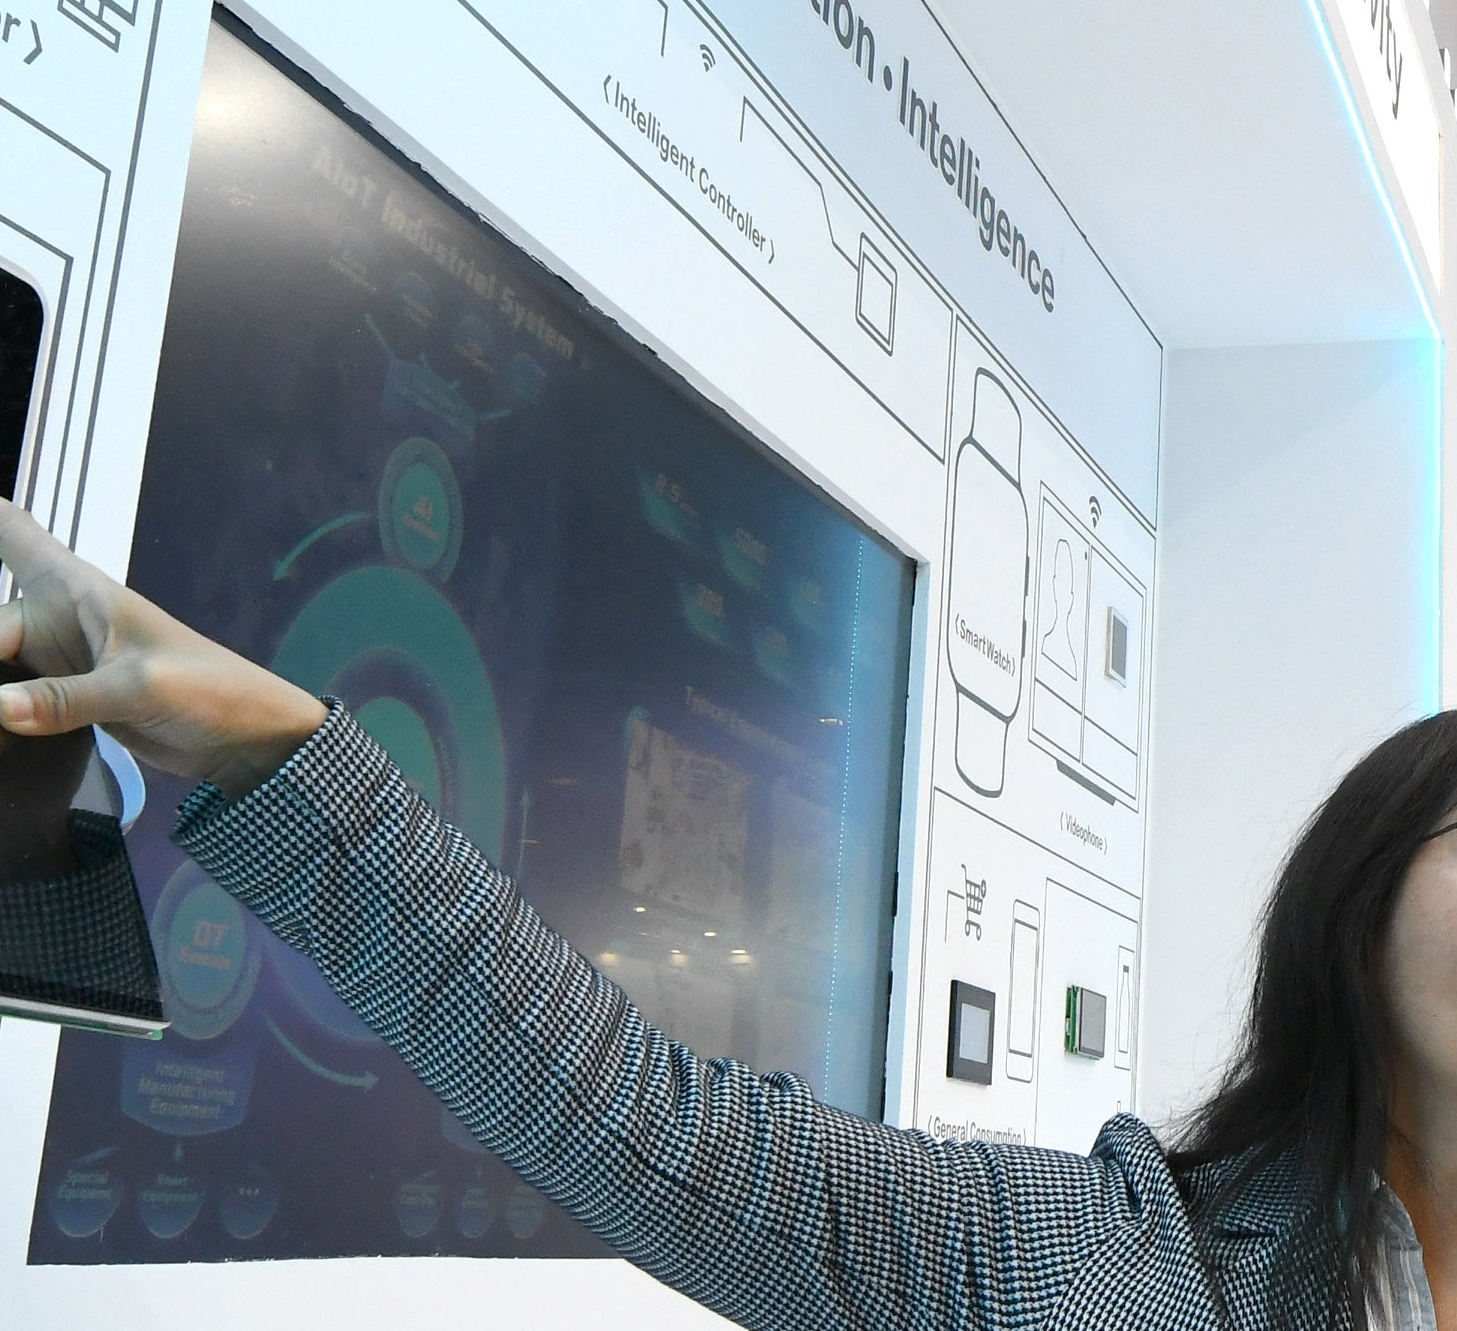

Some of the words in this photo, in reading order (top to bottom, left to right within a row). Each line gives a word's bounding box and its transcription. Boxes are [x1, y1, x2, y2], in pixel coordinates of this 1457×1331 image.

[614, 81, 696, 184] Intelligent
[698, 168, 766, 253] Controller
[898, 56, 1056, 313] Intelligence
[1064, 813, 1104, 853] Videophone
[933, 1115, 969, 1142] General
[969, 1121, 1023, 1145] Consumption
